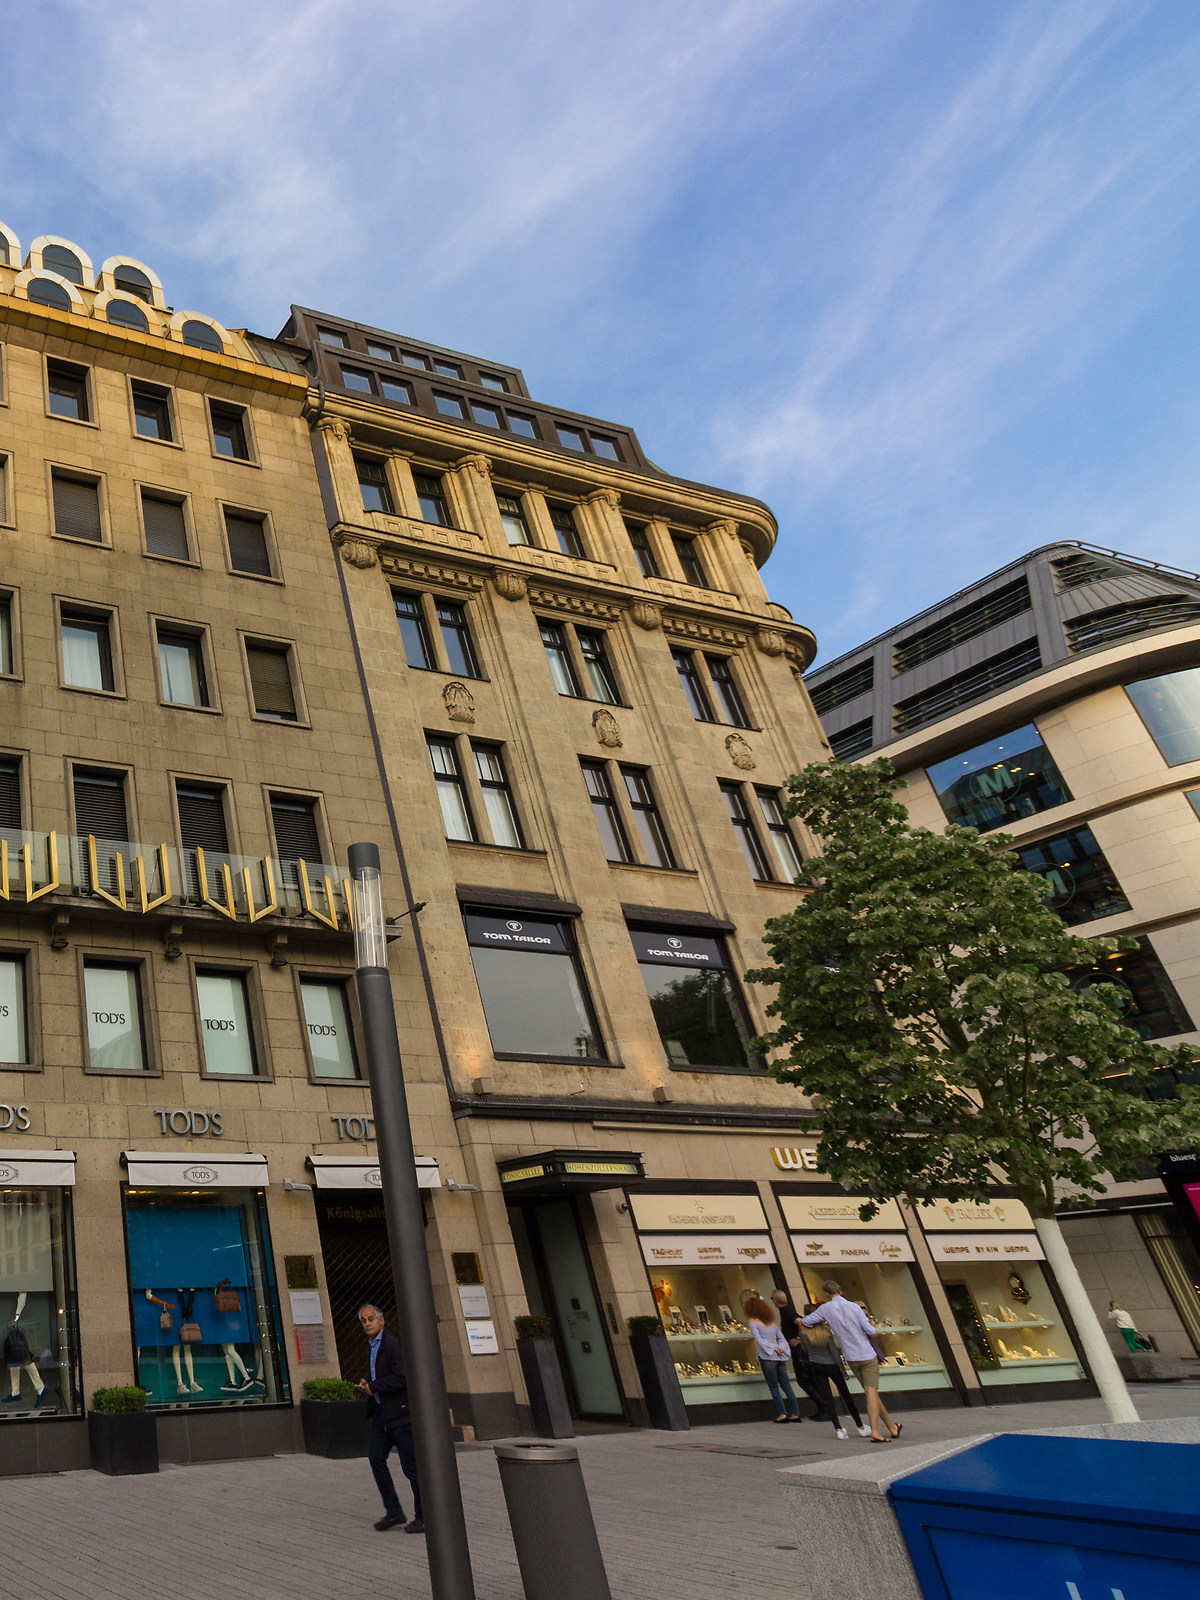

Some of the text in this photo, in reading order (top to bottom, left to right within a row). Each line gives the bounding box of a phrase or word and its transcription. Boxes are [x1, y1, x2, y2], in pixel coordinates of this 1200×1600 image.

[483, 932, 551, 944] TOM TAILOR
[647, 949, 709, 960] TOM TAILOR
[92, 1011, 126, 1024] TOD'S
[204, 1018, 235, 1031] TOD'S
[307, 1024, 337, 1036] TOD'S
[154, 1110, 224, 1136] TOD'S
[330, 1116, 377, 1140] TOD
[191, 1171, 210, 1179] TOD'S
[956, 1208, 994, 1219] ROLEX
